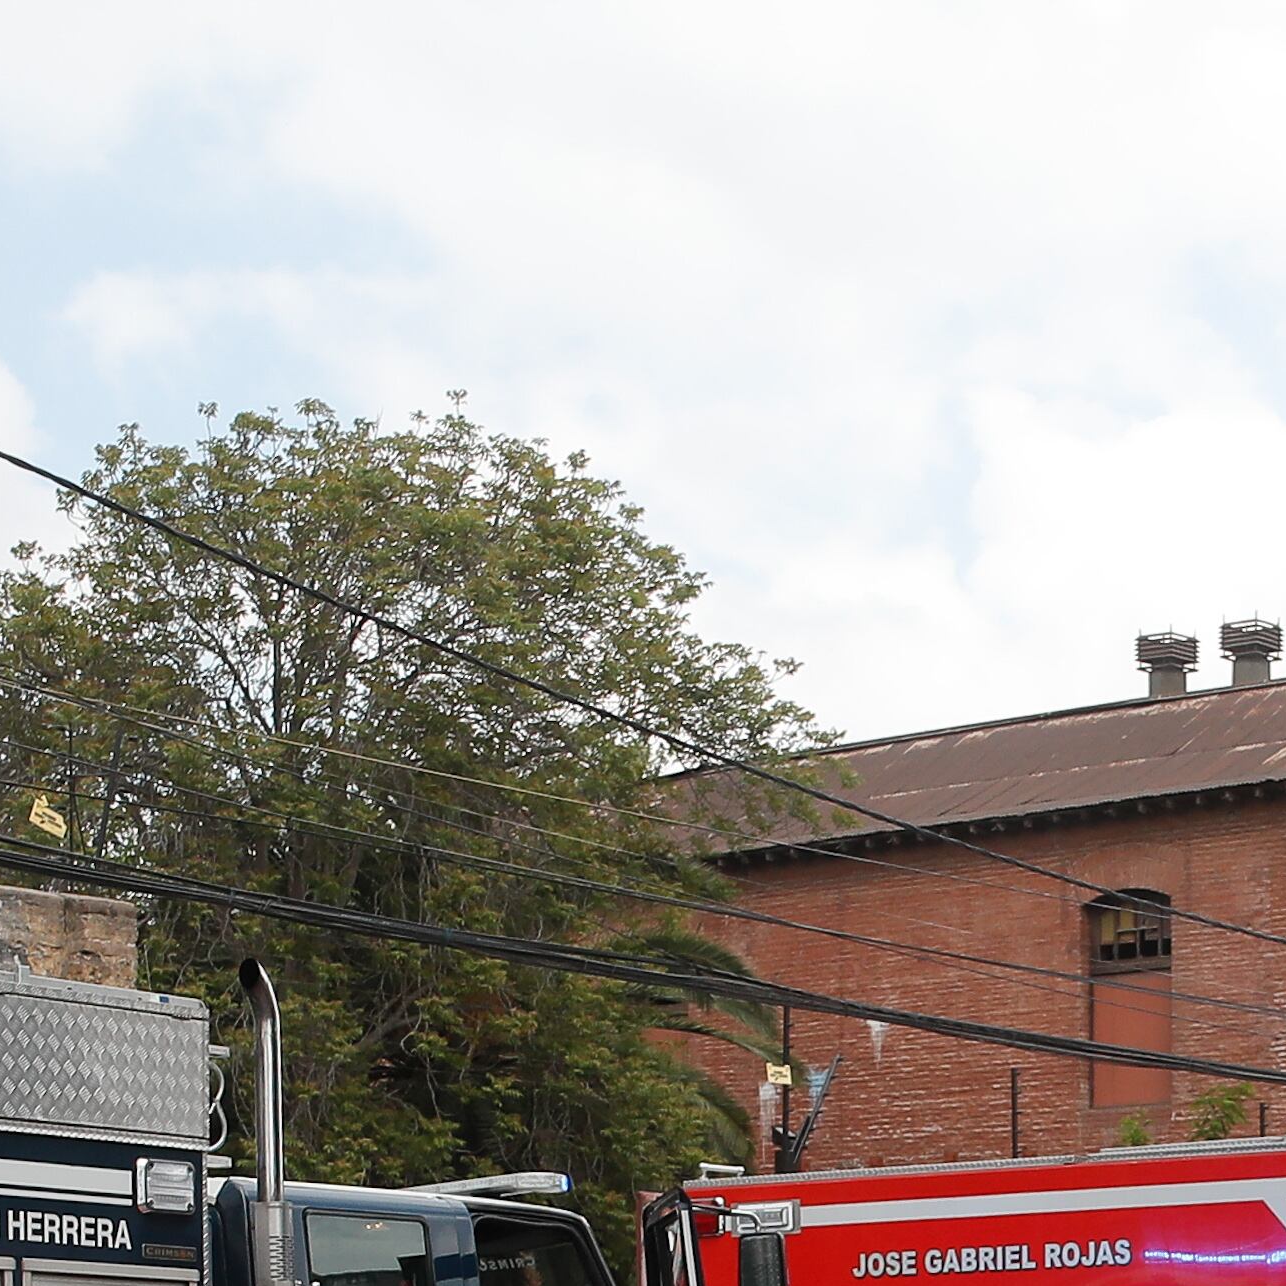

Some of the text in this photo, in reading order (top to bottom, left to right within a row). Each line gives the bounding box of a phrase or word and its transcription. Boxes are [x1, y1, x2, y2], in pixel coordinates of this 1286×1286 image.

[7, 1210, 132, 1250] HERRERA
[852, 1239, 1131, 1278] JOSE GABRIEL ROJAS
